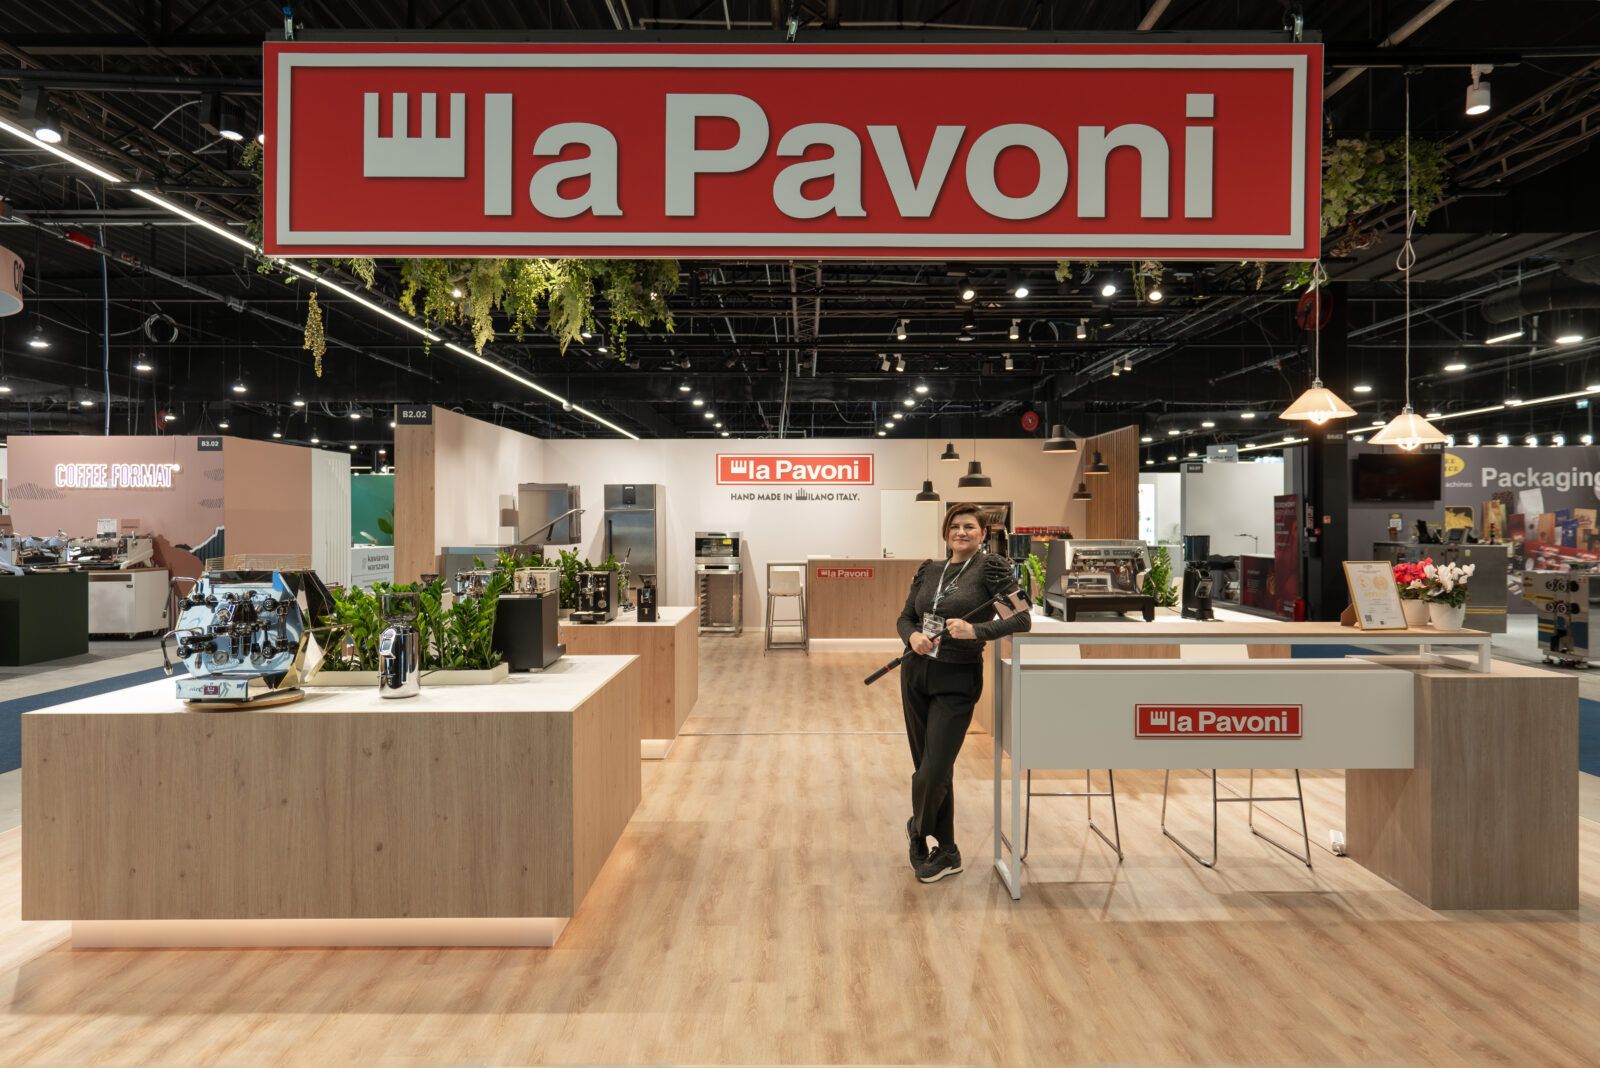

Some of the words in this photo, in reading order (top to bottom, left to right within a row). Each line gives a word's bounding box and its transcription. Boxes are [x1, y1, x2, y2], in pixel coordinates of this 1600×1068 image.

[483, 92, 624, 219] la
[665, 92, 1215, 219] Pavoni
[402, 410, 427, 418] B2.02
[55, 463, 108, 488] COFFEE
[112, 463, 173, 488] FORMAT
[749, 460, 770, 480] la
[776, 460, 859, 480] Pavoni
[730, 493, 755, 501] HAND
[757, 493, 781, 501] MADE
[783, 493, 792, 501] IN
[828, 569, 836, 577] la
[837, 569, 869, 577] Pavoni
[1169, 711, 1193, 732] la
[1198, 711, 1288, 732] Pavoni
